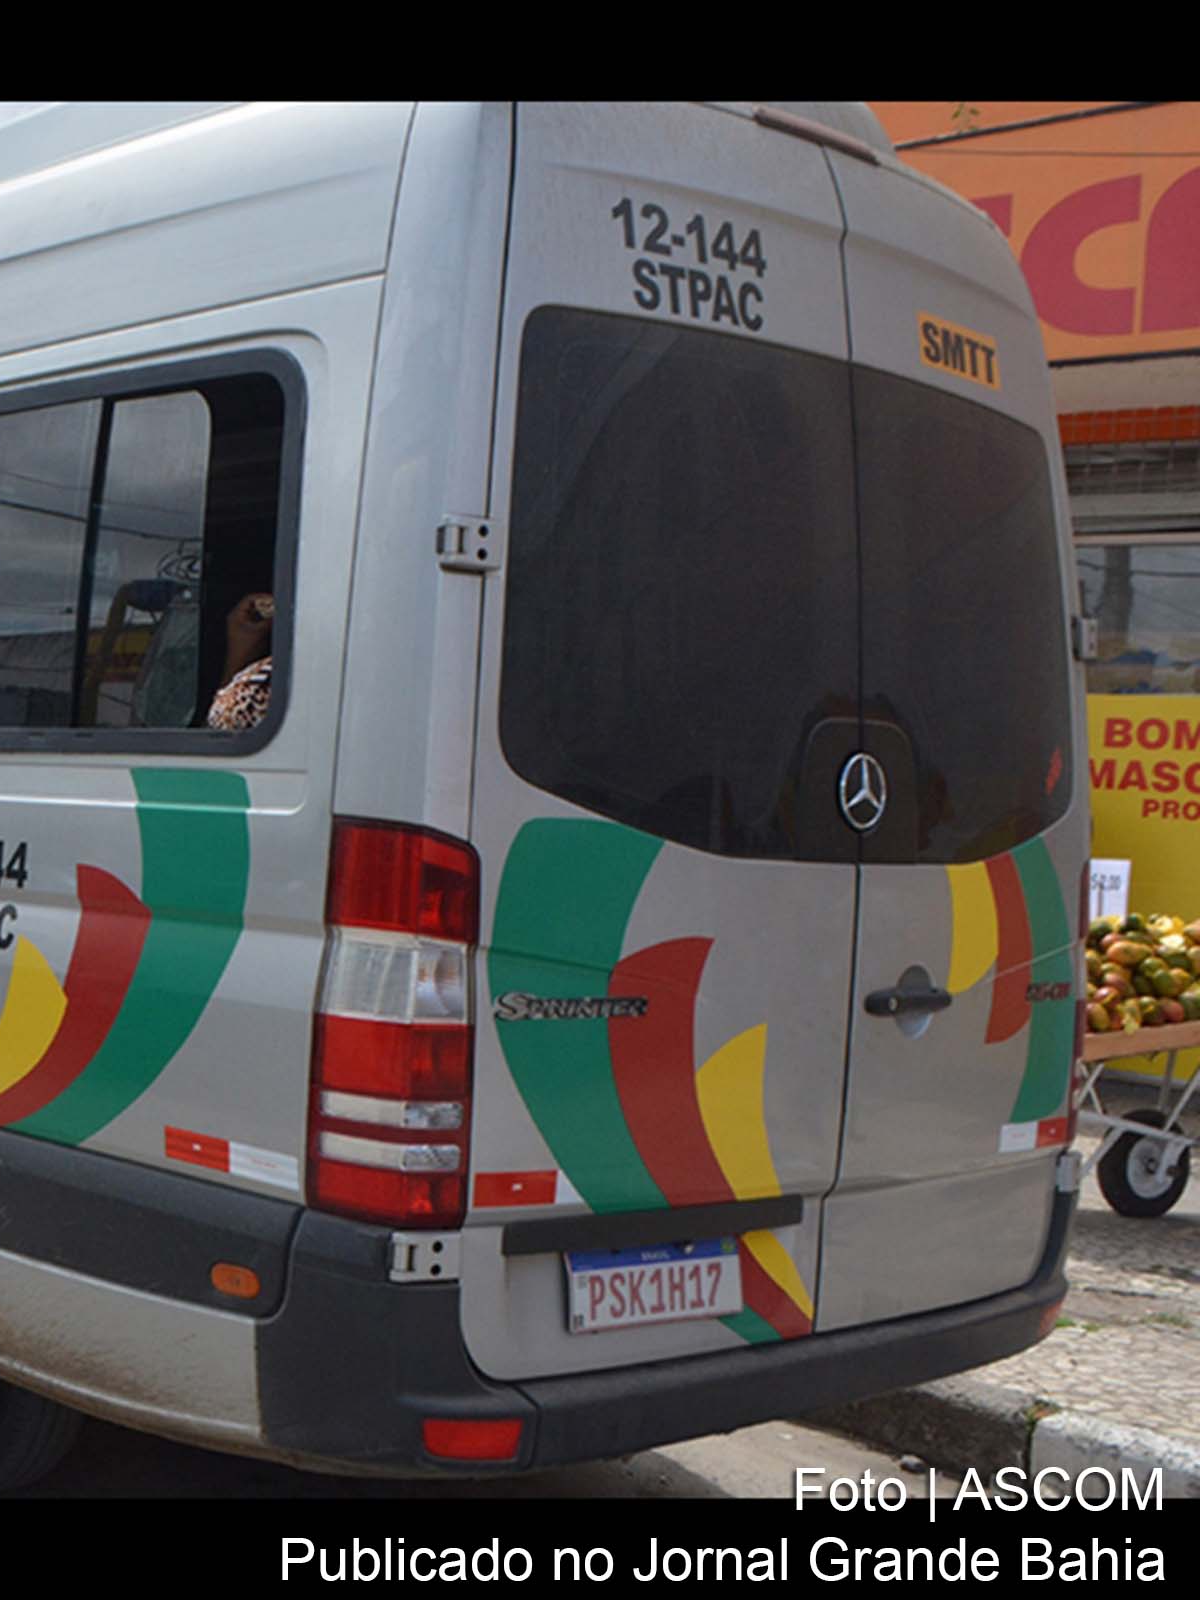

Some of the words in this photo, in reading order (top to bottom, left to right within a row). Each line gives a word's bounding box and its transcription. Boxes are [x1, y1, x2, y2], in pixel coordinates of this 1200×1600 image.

[611, 197, 767, 278] 12-144
[633, 258, 764, 331] STPAC
[922, 320, 995, 384] SMTT
[588, 1261, 722, 1321] PSK1H17
